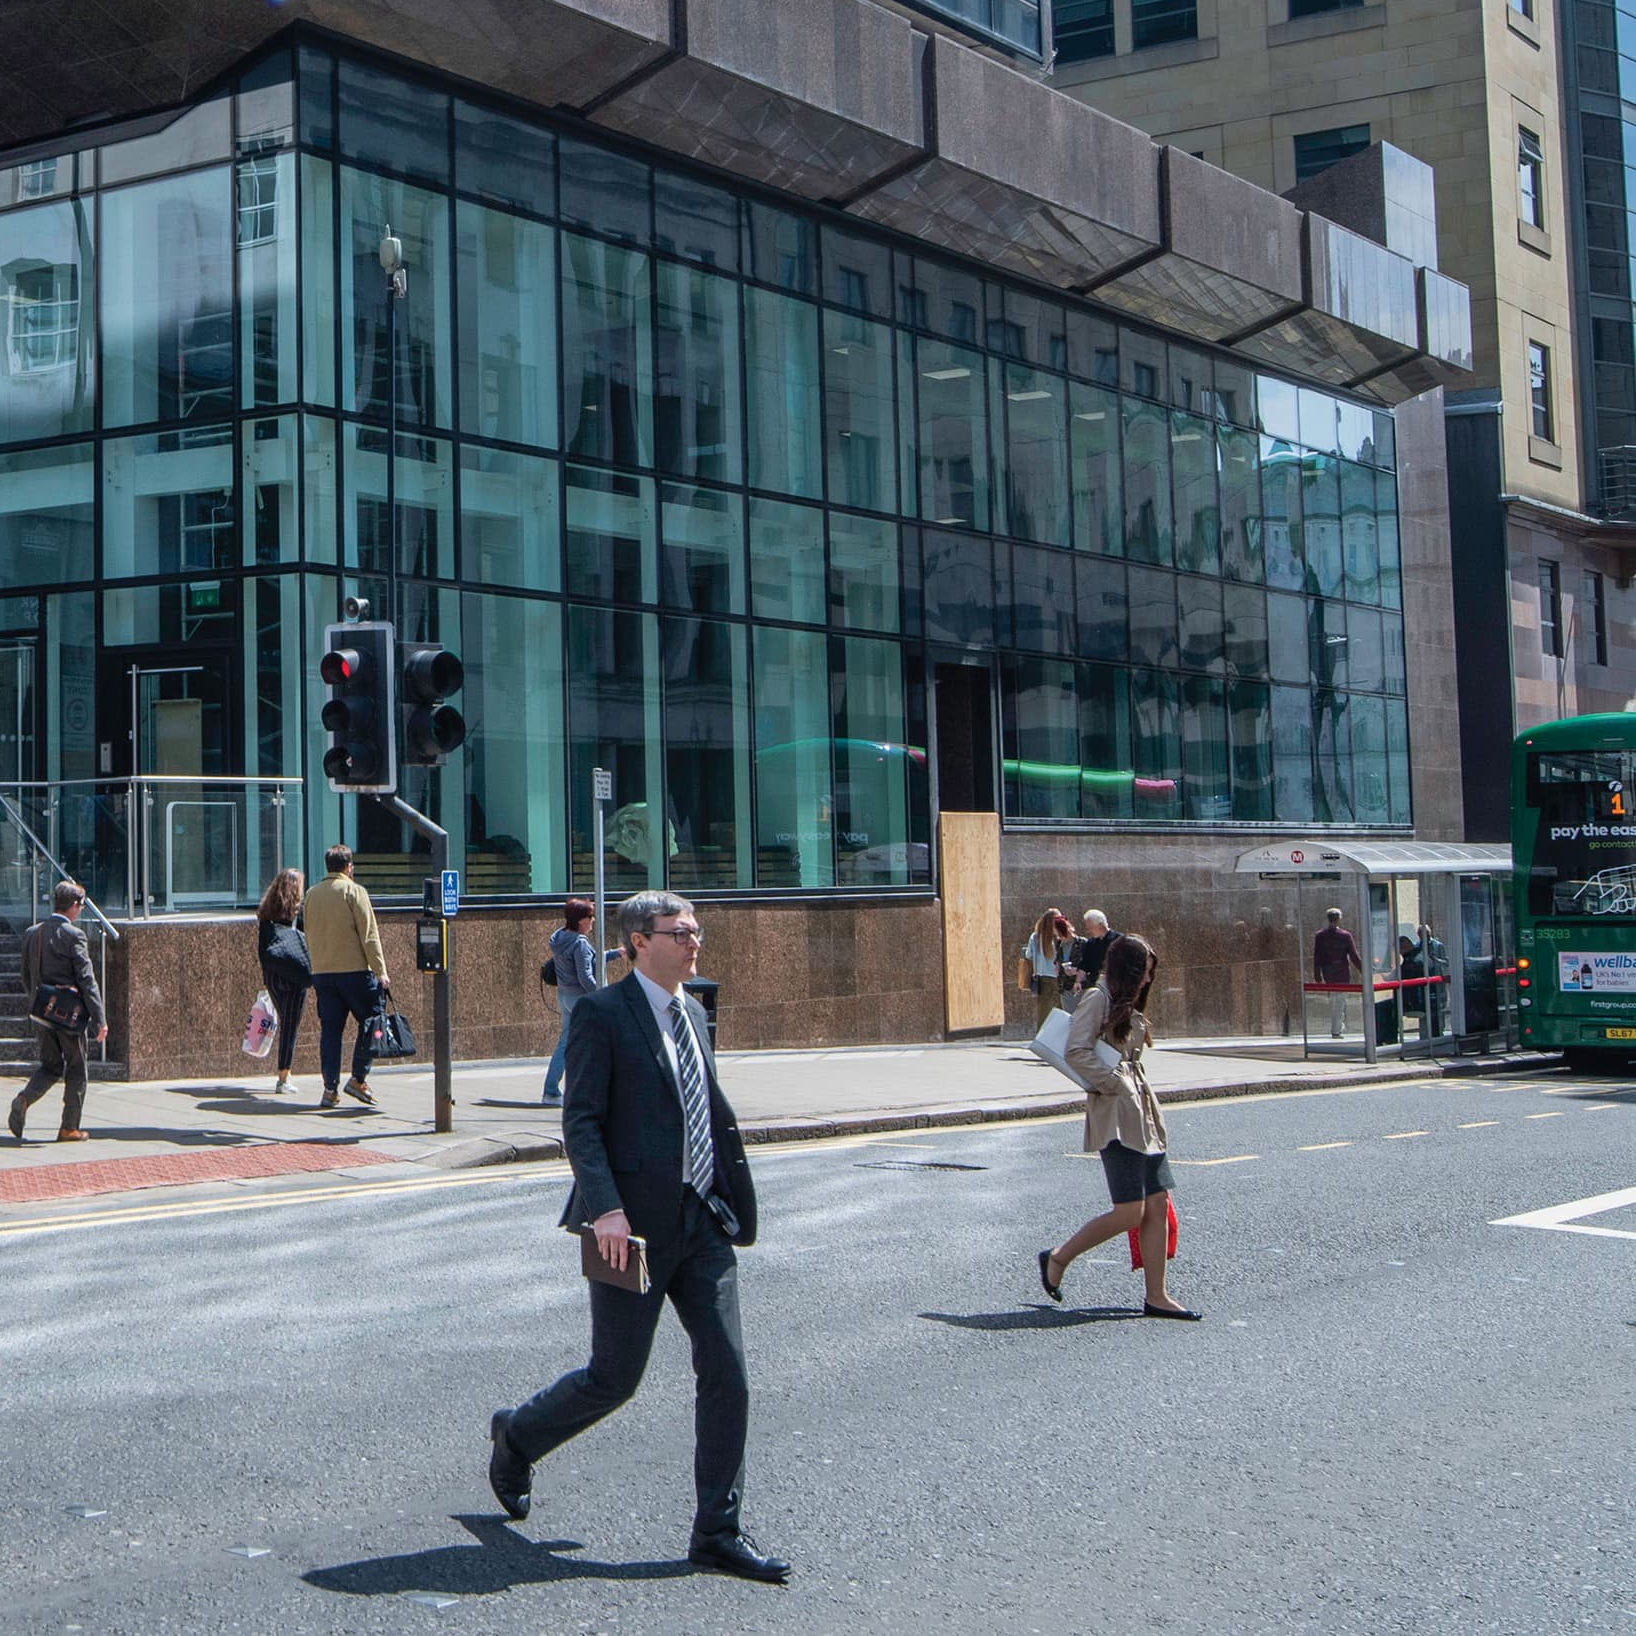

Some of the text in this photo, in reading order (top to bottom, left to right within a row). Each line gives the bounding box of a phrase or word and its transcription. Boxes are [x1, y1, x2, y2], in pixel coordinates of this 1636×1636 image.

[1611, 793, 1626, 814] 1
[1551, 826, 1580, 840] pay
[1582, 823, 1609, 836] the
[1589, 841, 1601, 850] go
[1536, 929, 1570, 939] 35283
